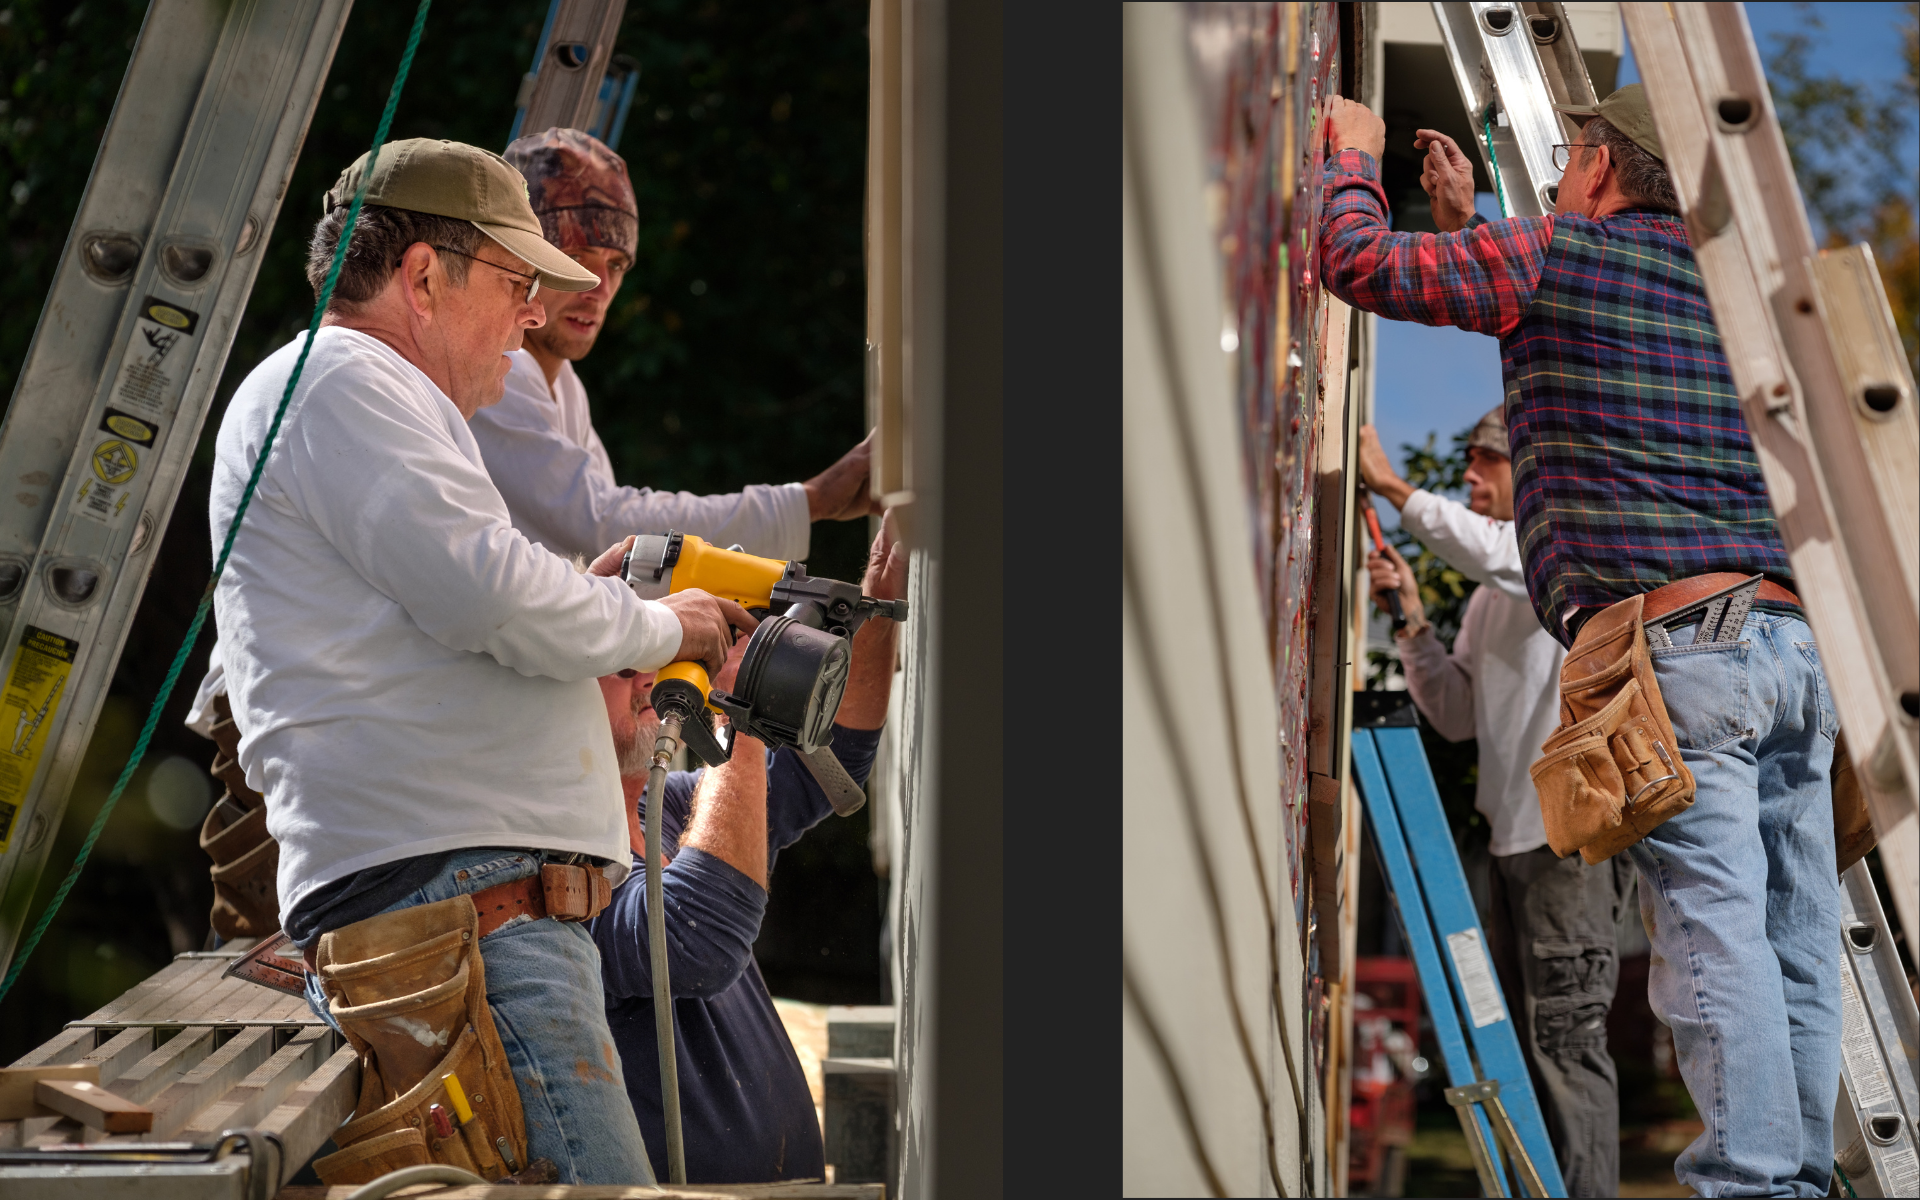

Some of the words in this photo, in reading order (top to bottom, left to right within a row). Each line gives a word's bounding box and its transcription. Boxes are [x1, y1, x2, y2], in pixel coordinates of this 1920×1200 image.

[36, 631, 66, 647] CAUTION
[1658, 633, 1667, 647] PIVOT
[26, 638, 68, 659] PRECAUCIÓN
